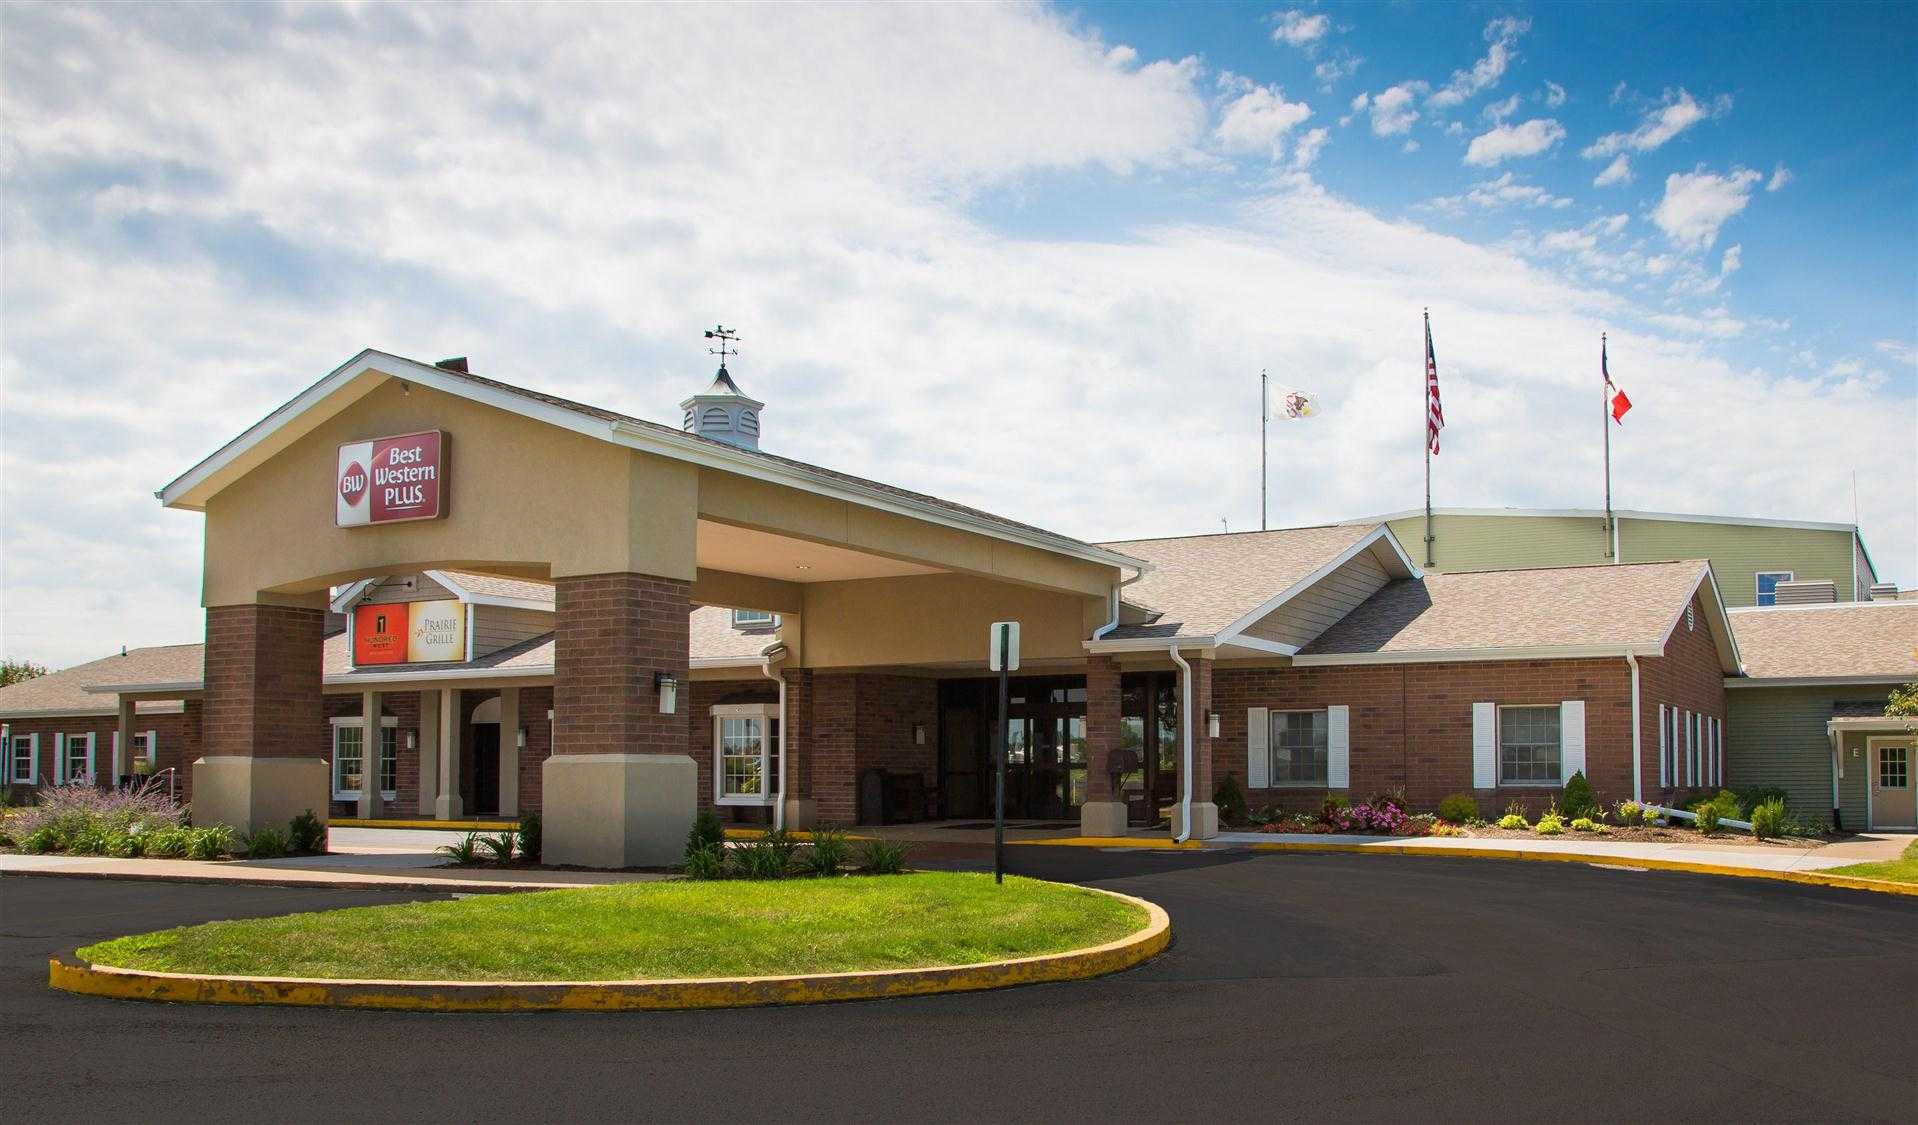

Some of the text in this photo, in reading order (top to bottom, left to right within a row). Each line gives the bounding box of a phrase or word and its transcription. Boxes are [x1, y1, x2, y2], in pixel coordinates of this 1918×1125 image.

[389, 446, 423, 465] Best
[343, 474, 364, 493] BW
[375, 465, 436, 486] Western
[423, 617, 457, 630] PRAIRIE
[425, 631, 454, 645] GRILLE
